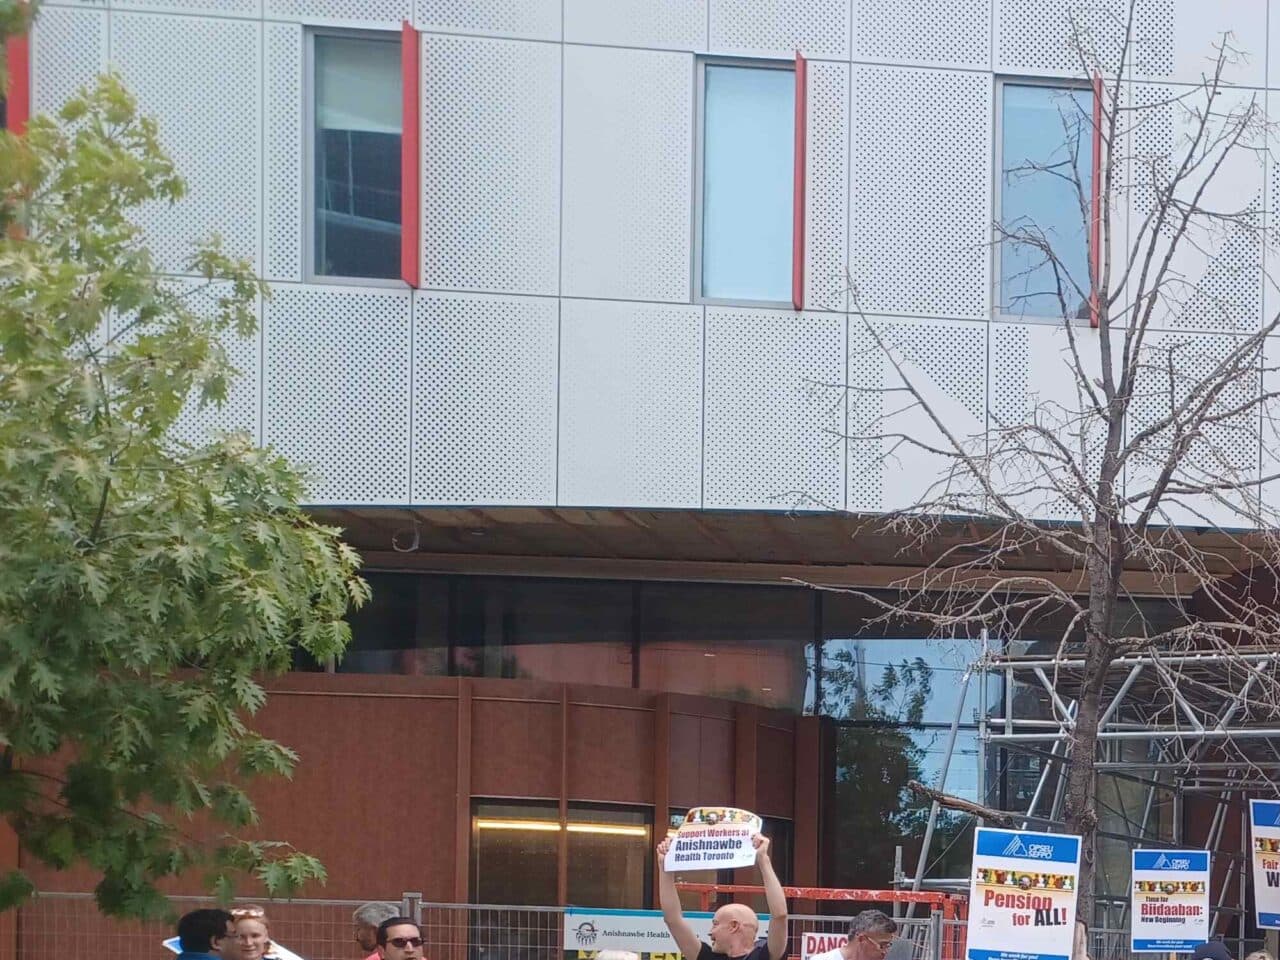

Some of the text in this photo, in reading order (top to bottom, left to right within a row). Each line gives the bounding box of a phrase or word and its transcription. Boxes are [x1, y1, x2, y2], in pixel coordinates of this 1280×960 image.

[707, 829, 740, 837] Workers
[675, 838, 742, 851] Anishnawbe
[675, 852, 734, 862] Health Toronto
[1262, 859, 1278, 870] Fair
[984, 889, 1053, 910] Pension
[1141, 904, 1203, 916] Biidaaban:
[1012, 913, 1031, 926] for
[1034, 908, 1067, 927] ALL!
[1155, 916, 1185, 924] Beginning
[602, 930, 645, 938] Anishnawbe
